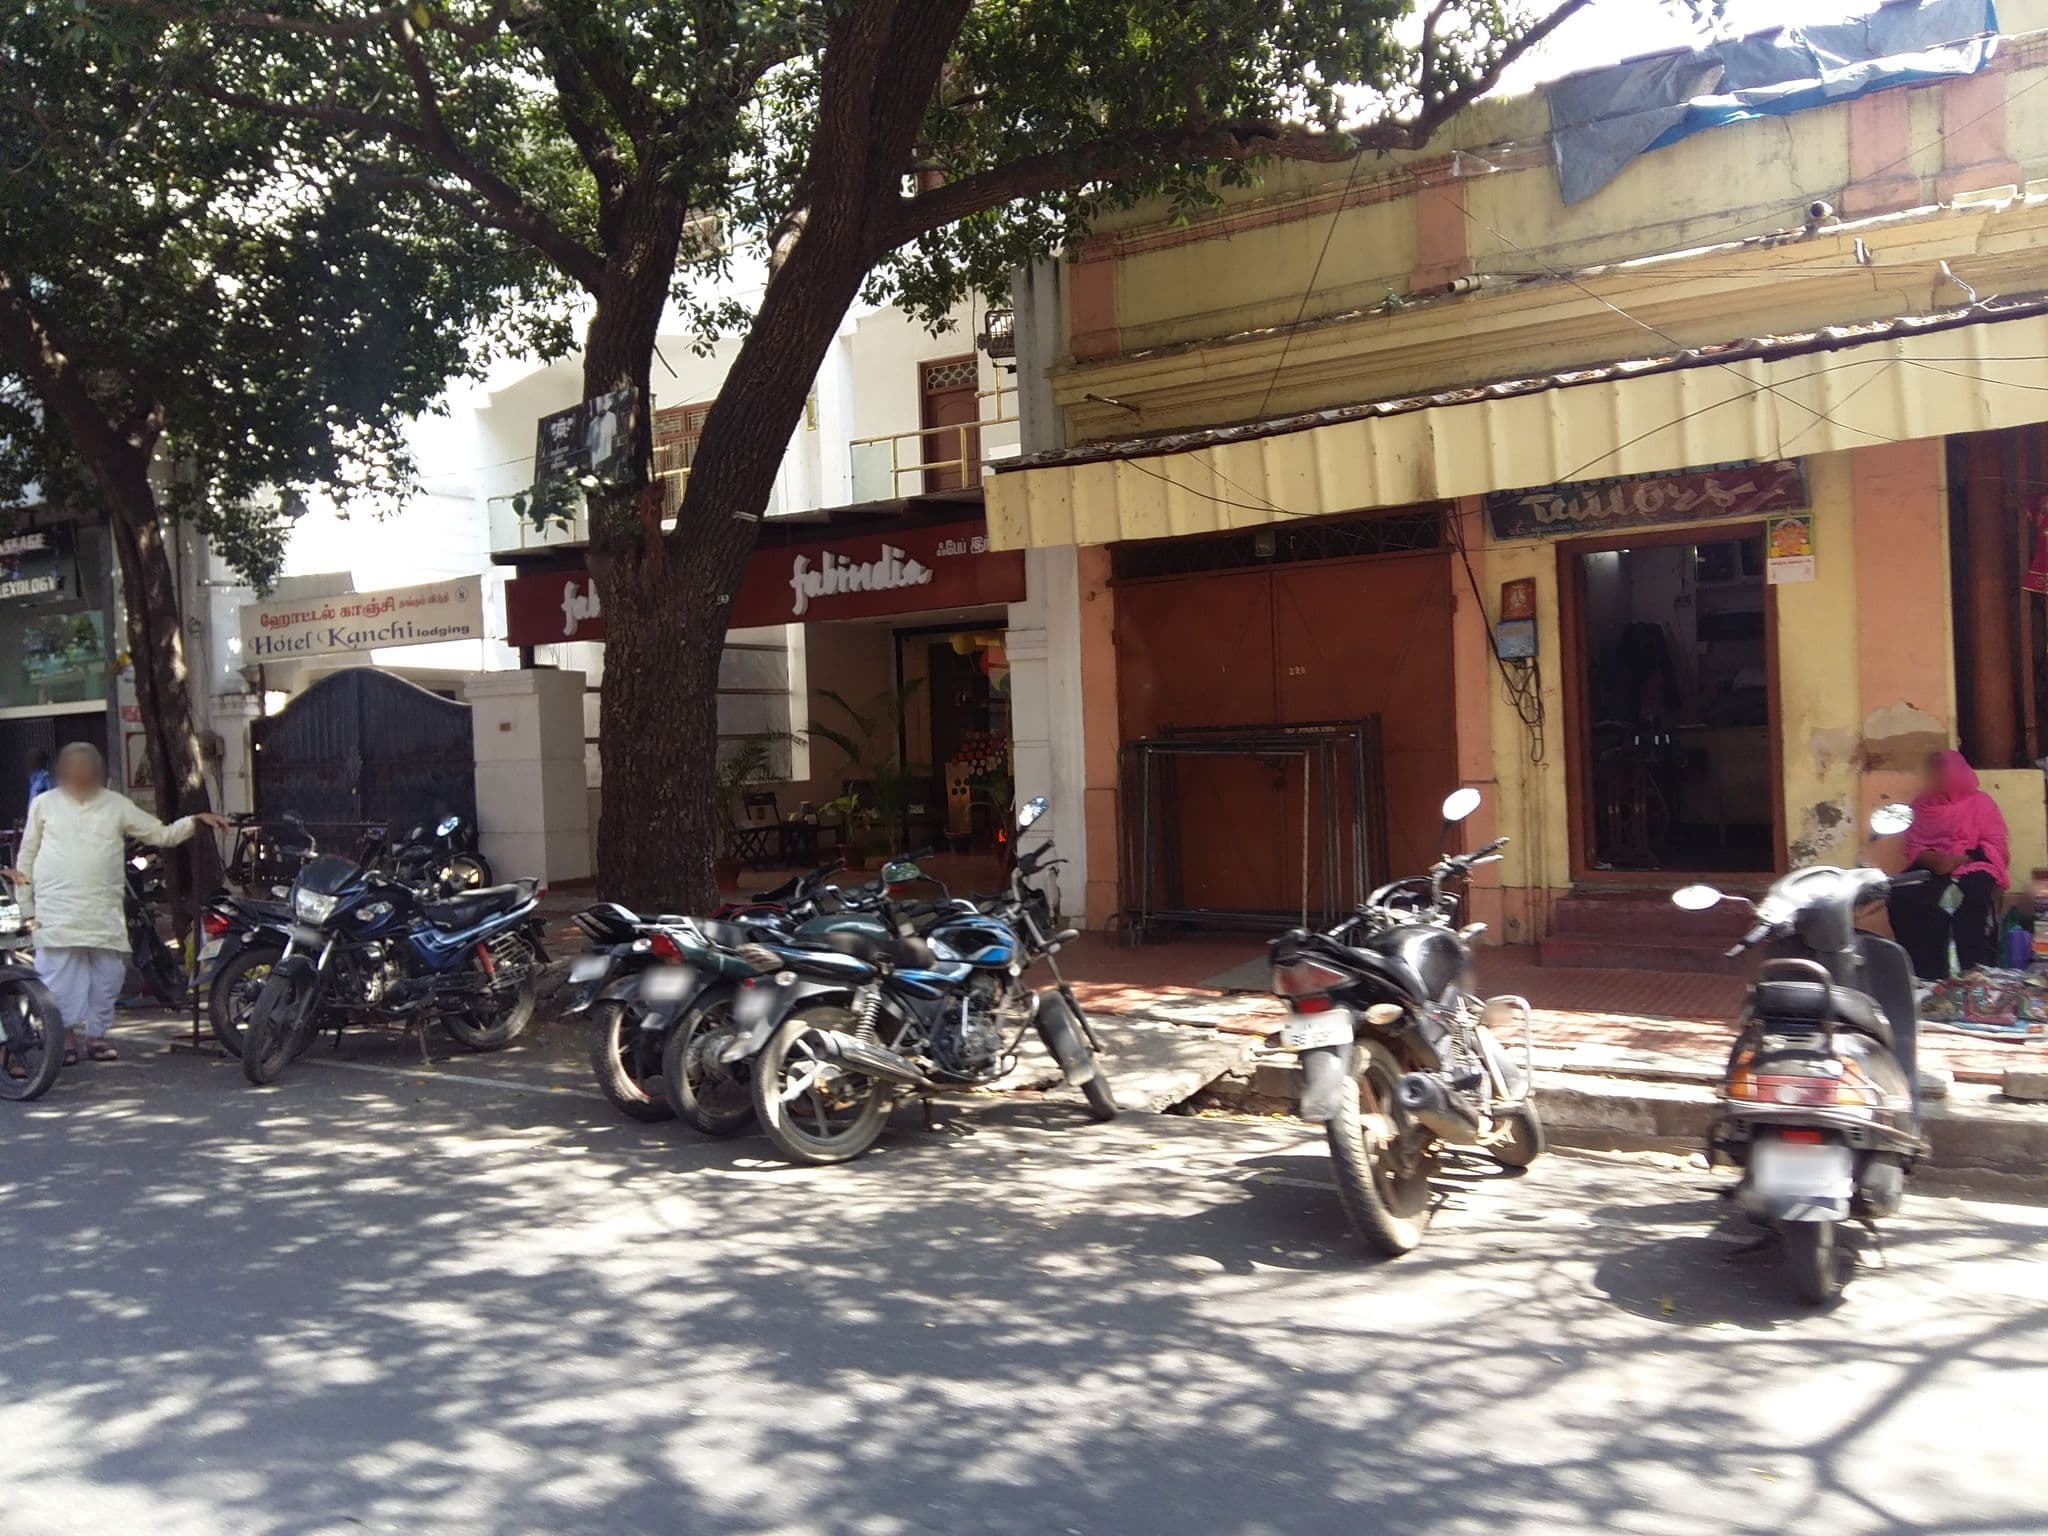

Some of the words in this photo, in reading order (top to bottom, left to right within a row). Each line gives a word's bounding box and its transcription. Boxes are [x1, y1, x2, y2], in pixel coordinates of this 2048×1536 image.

[788, 543, 933, 615] fabindia
[340, 596, 395, 618] காஞ்சி
[248, 631, 313, 655] Hotel
[317, 620, 413, 650] Kanchi
[416, 624, 470, 638] lodging
